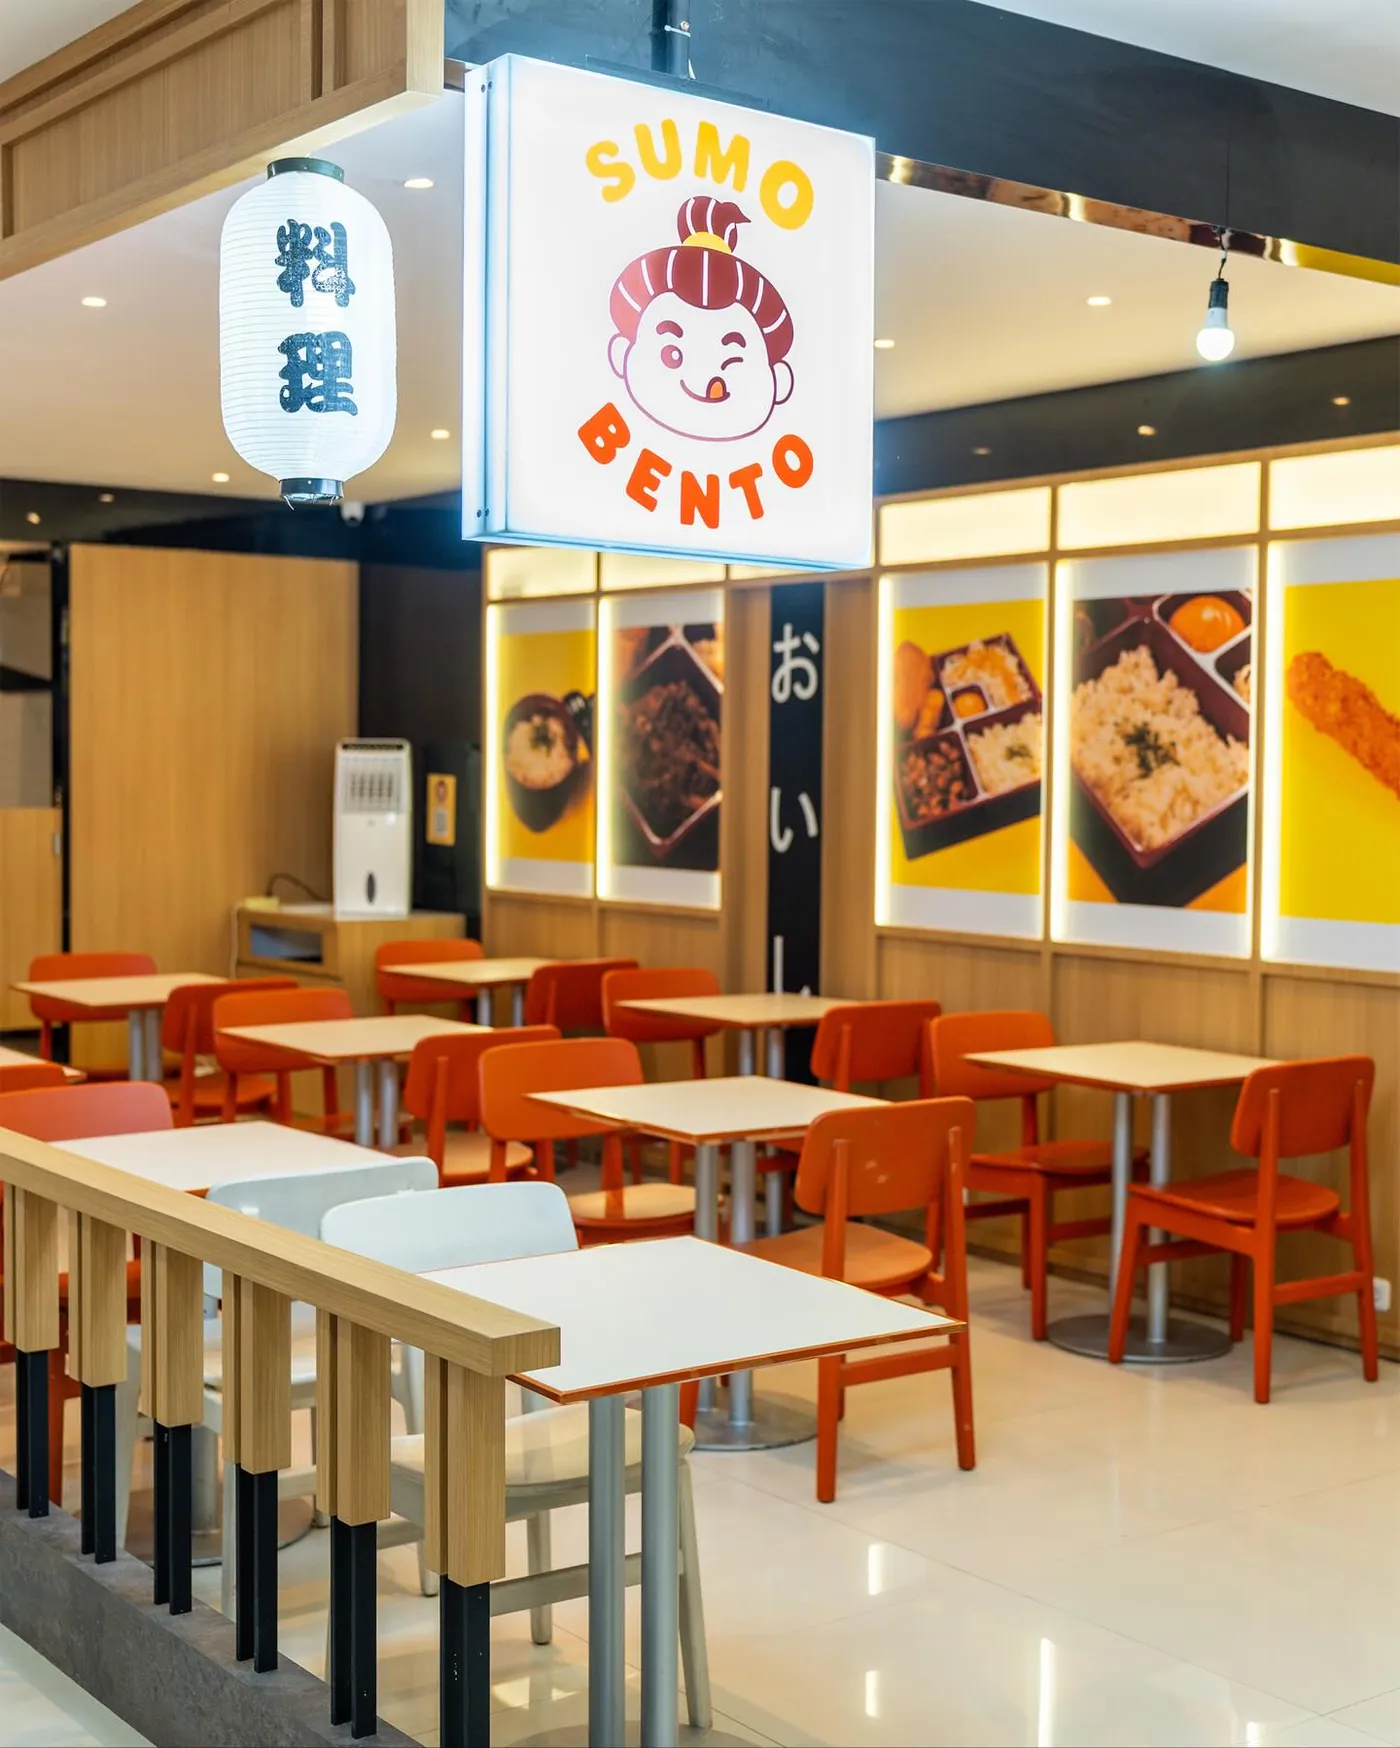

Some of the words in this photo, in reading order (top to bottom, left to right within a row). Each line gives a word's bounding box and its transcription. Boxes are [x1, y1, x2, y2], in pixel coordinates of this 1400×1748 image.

[586, 119, 814, 230] SUMO
[275, 218, 358, 416] 料理
[578, 402, 814, 529] BENTO
